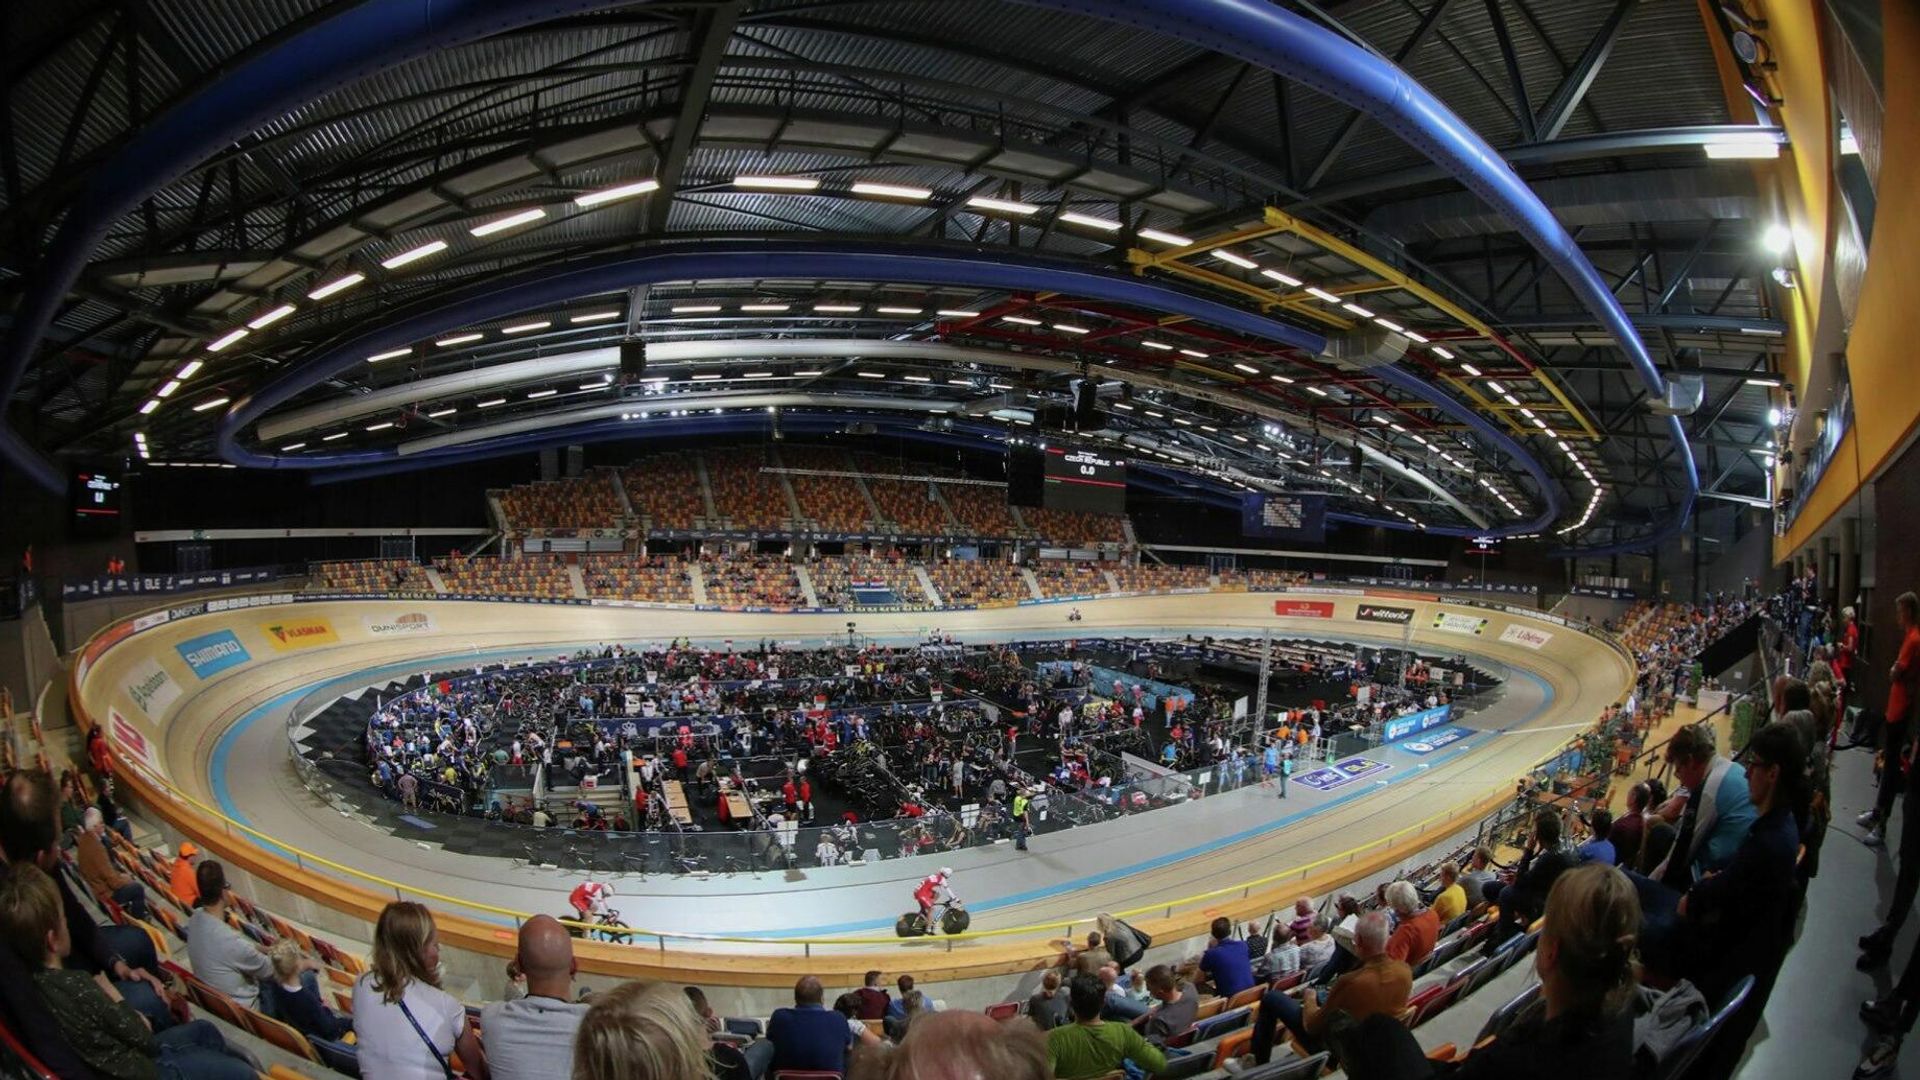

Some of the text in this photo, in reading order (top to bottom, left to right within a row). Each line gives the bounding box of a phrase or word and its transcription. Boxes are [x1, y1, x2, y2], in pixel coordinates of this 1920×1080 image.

[1371, 608, 1409, 621] vittoria
[288, 625, 327, 638] VLASMAN
[371, 622, 430, 633] OMNISPORT
[185, 640, 241, 668] SHIMANO
